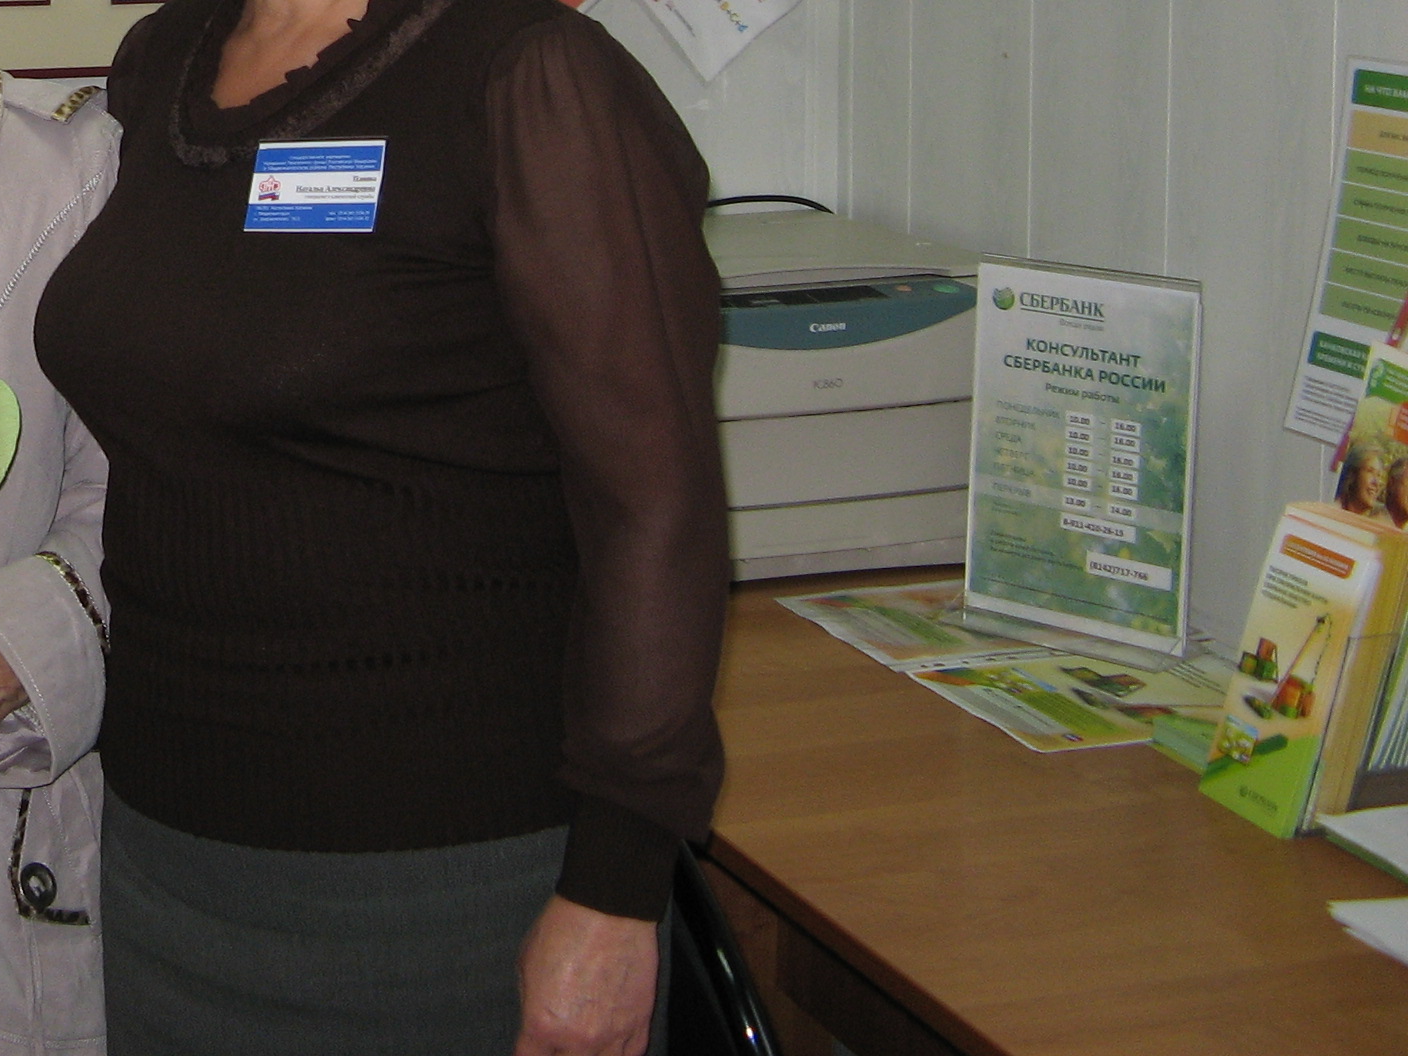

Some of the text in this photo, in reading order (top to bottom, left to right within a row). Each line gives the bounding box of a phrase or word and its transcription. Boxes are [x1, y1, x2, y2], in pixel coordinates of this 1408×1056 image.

[1019, 291, 1105, 318] СБЕРБАНК
[809, 322, 847, 333] Canon
[1026, 338, 1141, 368] КОНСУЛЬТАНТ
[1003, 354, 1166, 393] СБЕРБАНКА РОССИИ
[1045, 382, 1120, 404] Режим работы
